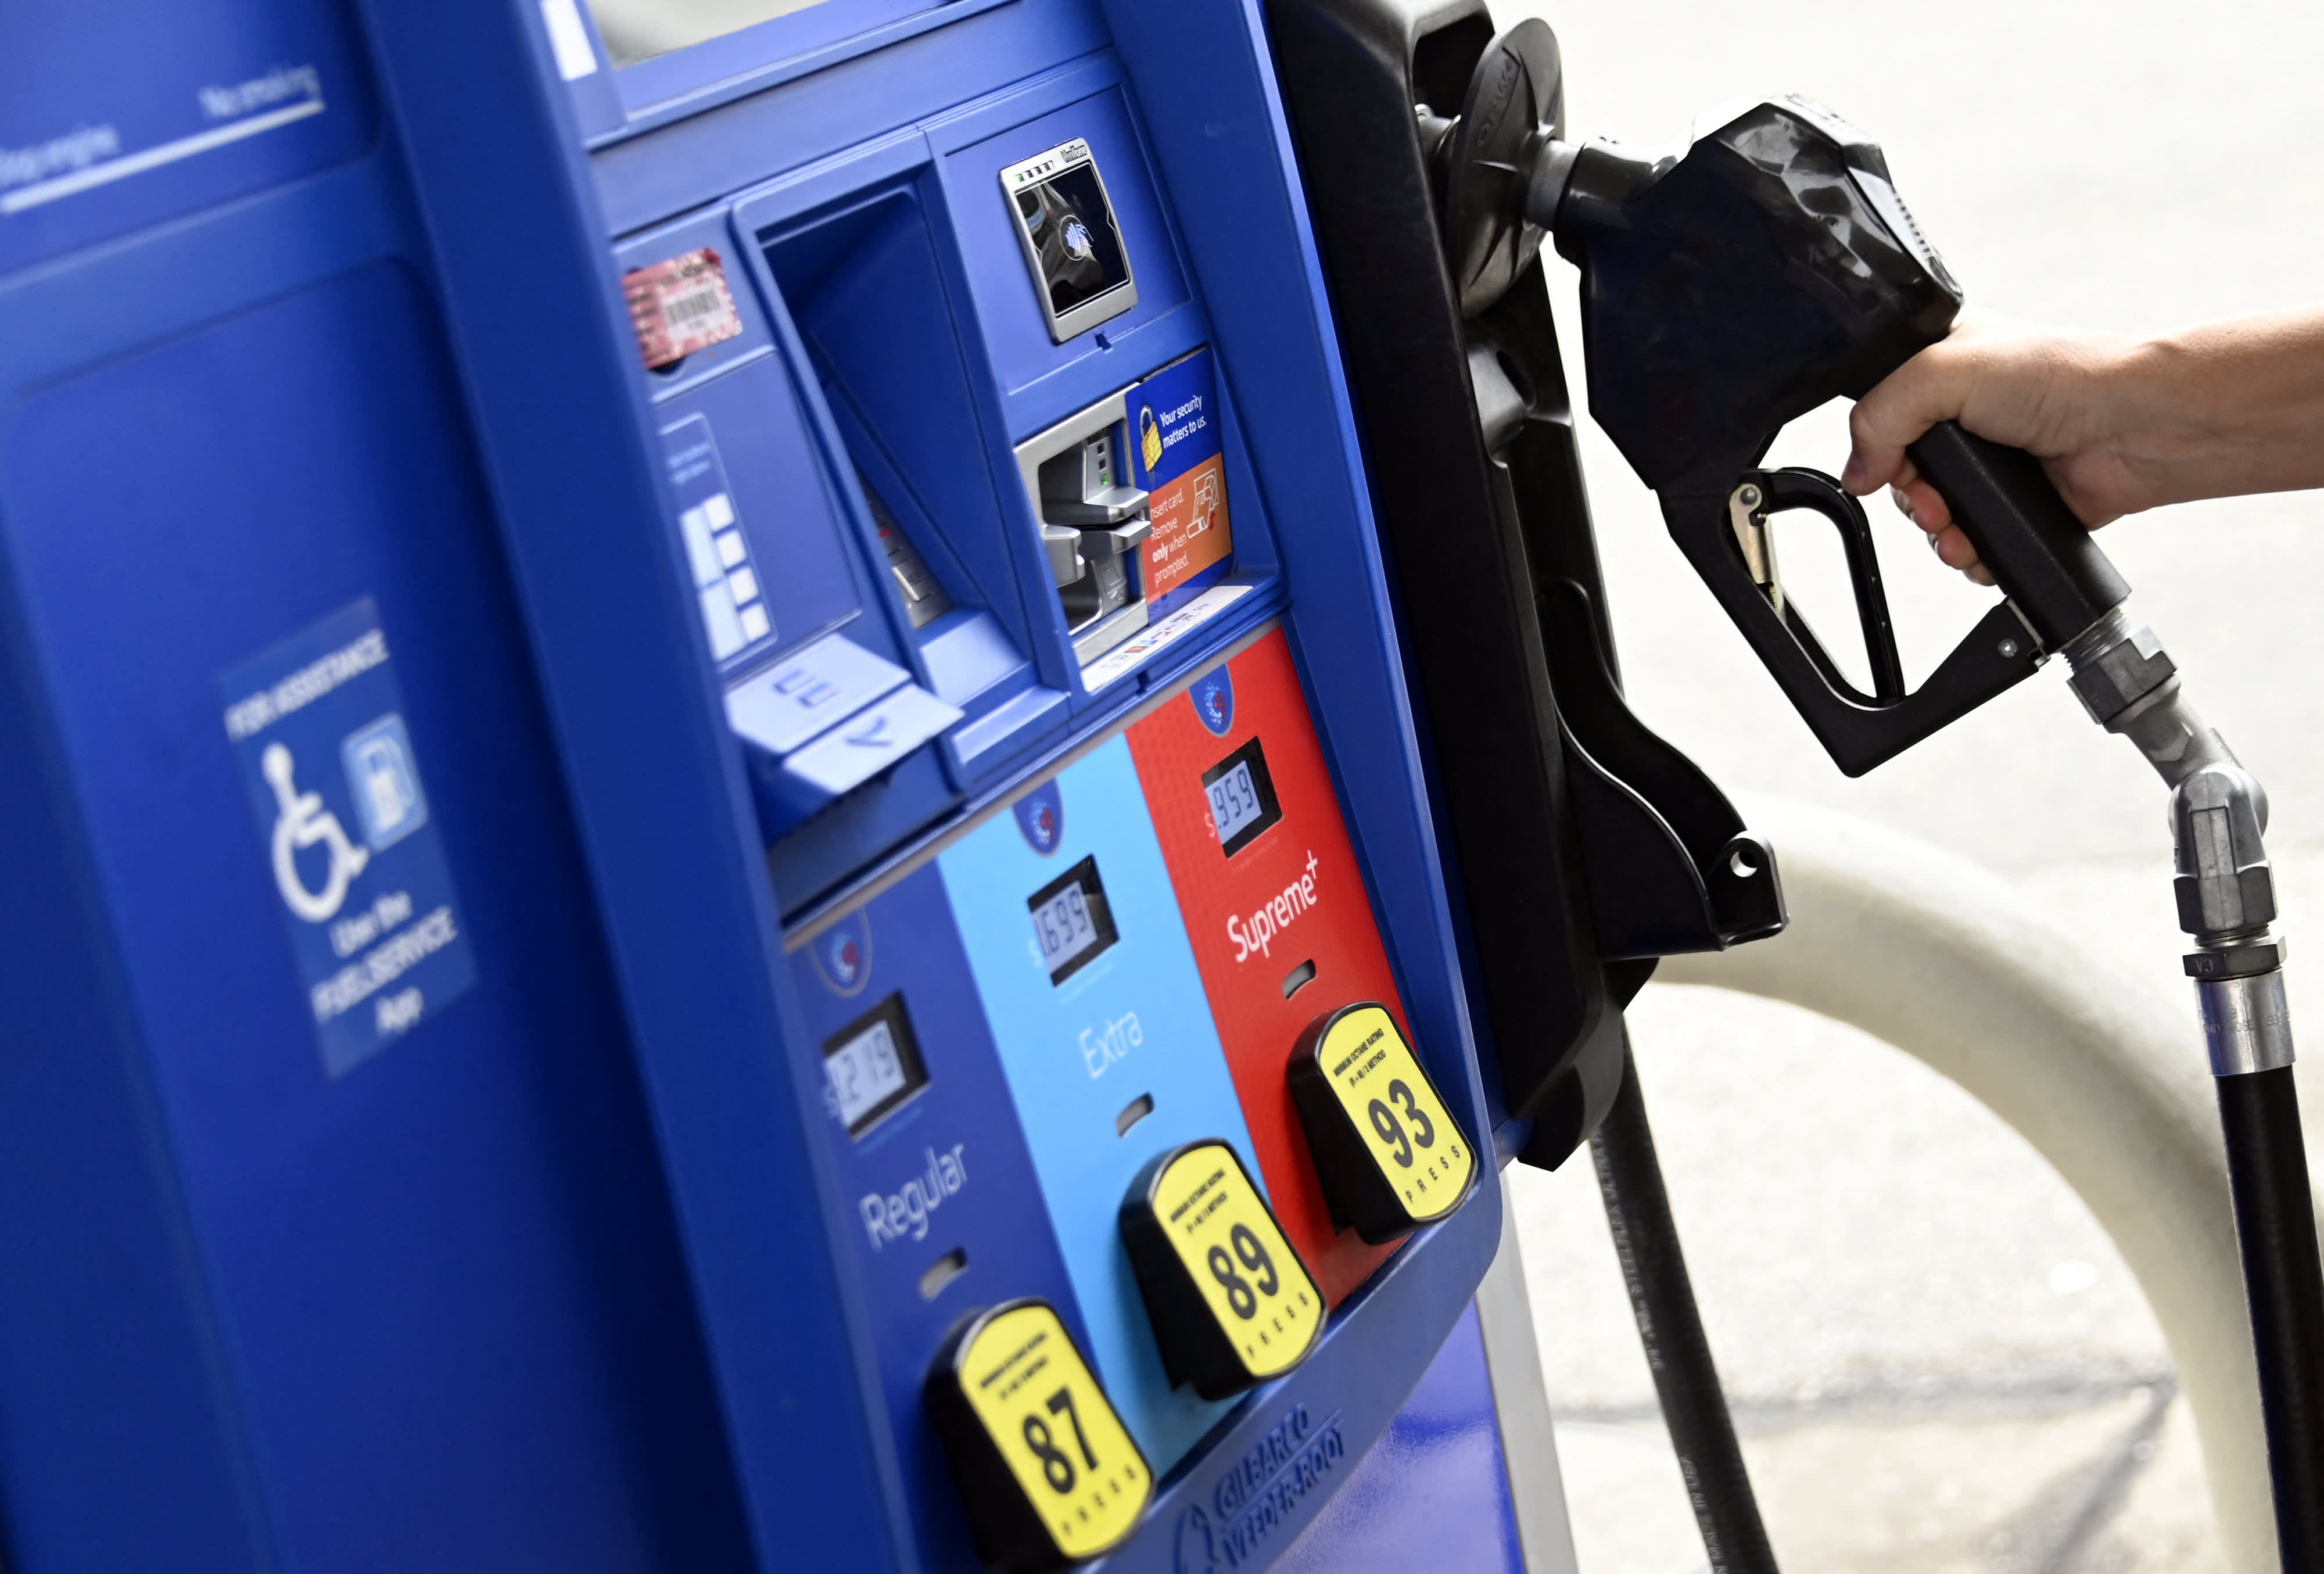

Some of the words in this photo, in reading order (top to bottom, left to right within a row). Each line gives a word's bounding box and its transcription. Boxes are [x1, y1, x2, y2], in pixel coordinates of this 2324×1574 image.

[1160, 410, 1176, 427] Your
[1177, 395, 1202, 418] security
[1163, 424, 1189, 449] matters
[1189, 420, 1197, 433] to
[1196, 415, 1207, 430] us.
[1150, 500, 1168, 519] nsert
[1168, 487, 1184, 510] card.
[1151, 517, 1178, 543] Remove
[1153, 543, 1169, 563] only
[1168, 533, 1187, 553] when
[1155, 551, 1189, 587] prompted.
[1079, 1010, 1143, 1080] Extra
[1350, 1042, 1369, 1061] OCTANE
[1367, 1028, 1384, 1046] RATING
[1367, 1049, 1386, 1069] METHOD
[1368, 1079, 1434, 1168] 93
[858, 1143, 968, 1253] Regular
[1207, 1222, 1278, 1320] 89
[1021, 1385, 1099, 1494] 87
[1214, 1401, 1308, 1519] GILBARCO
